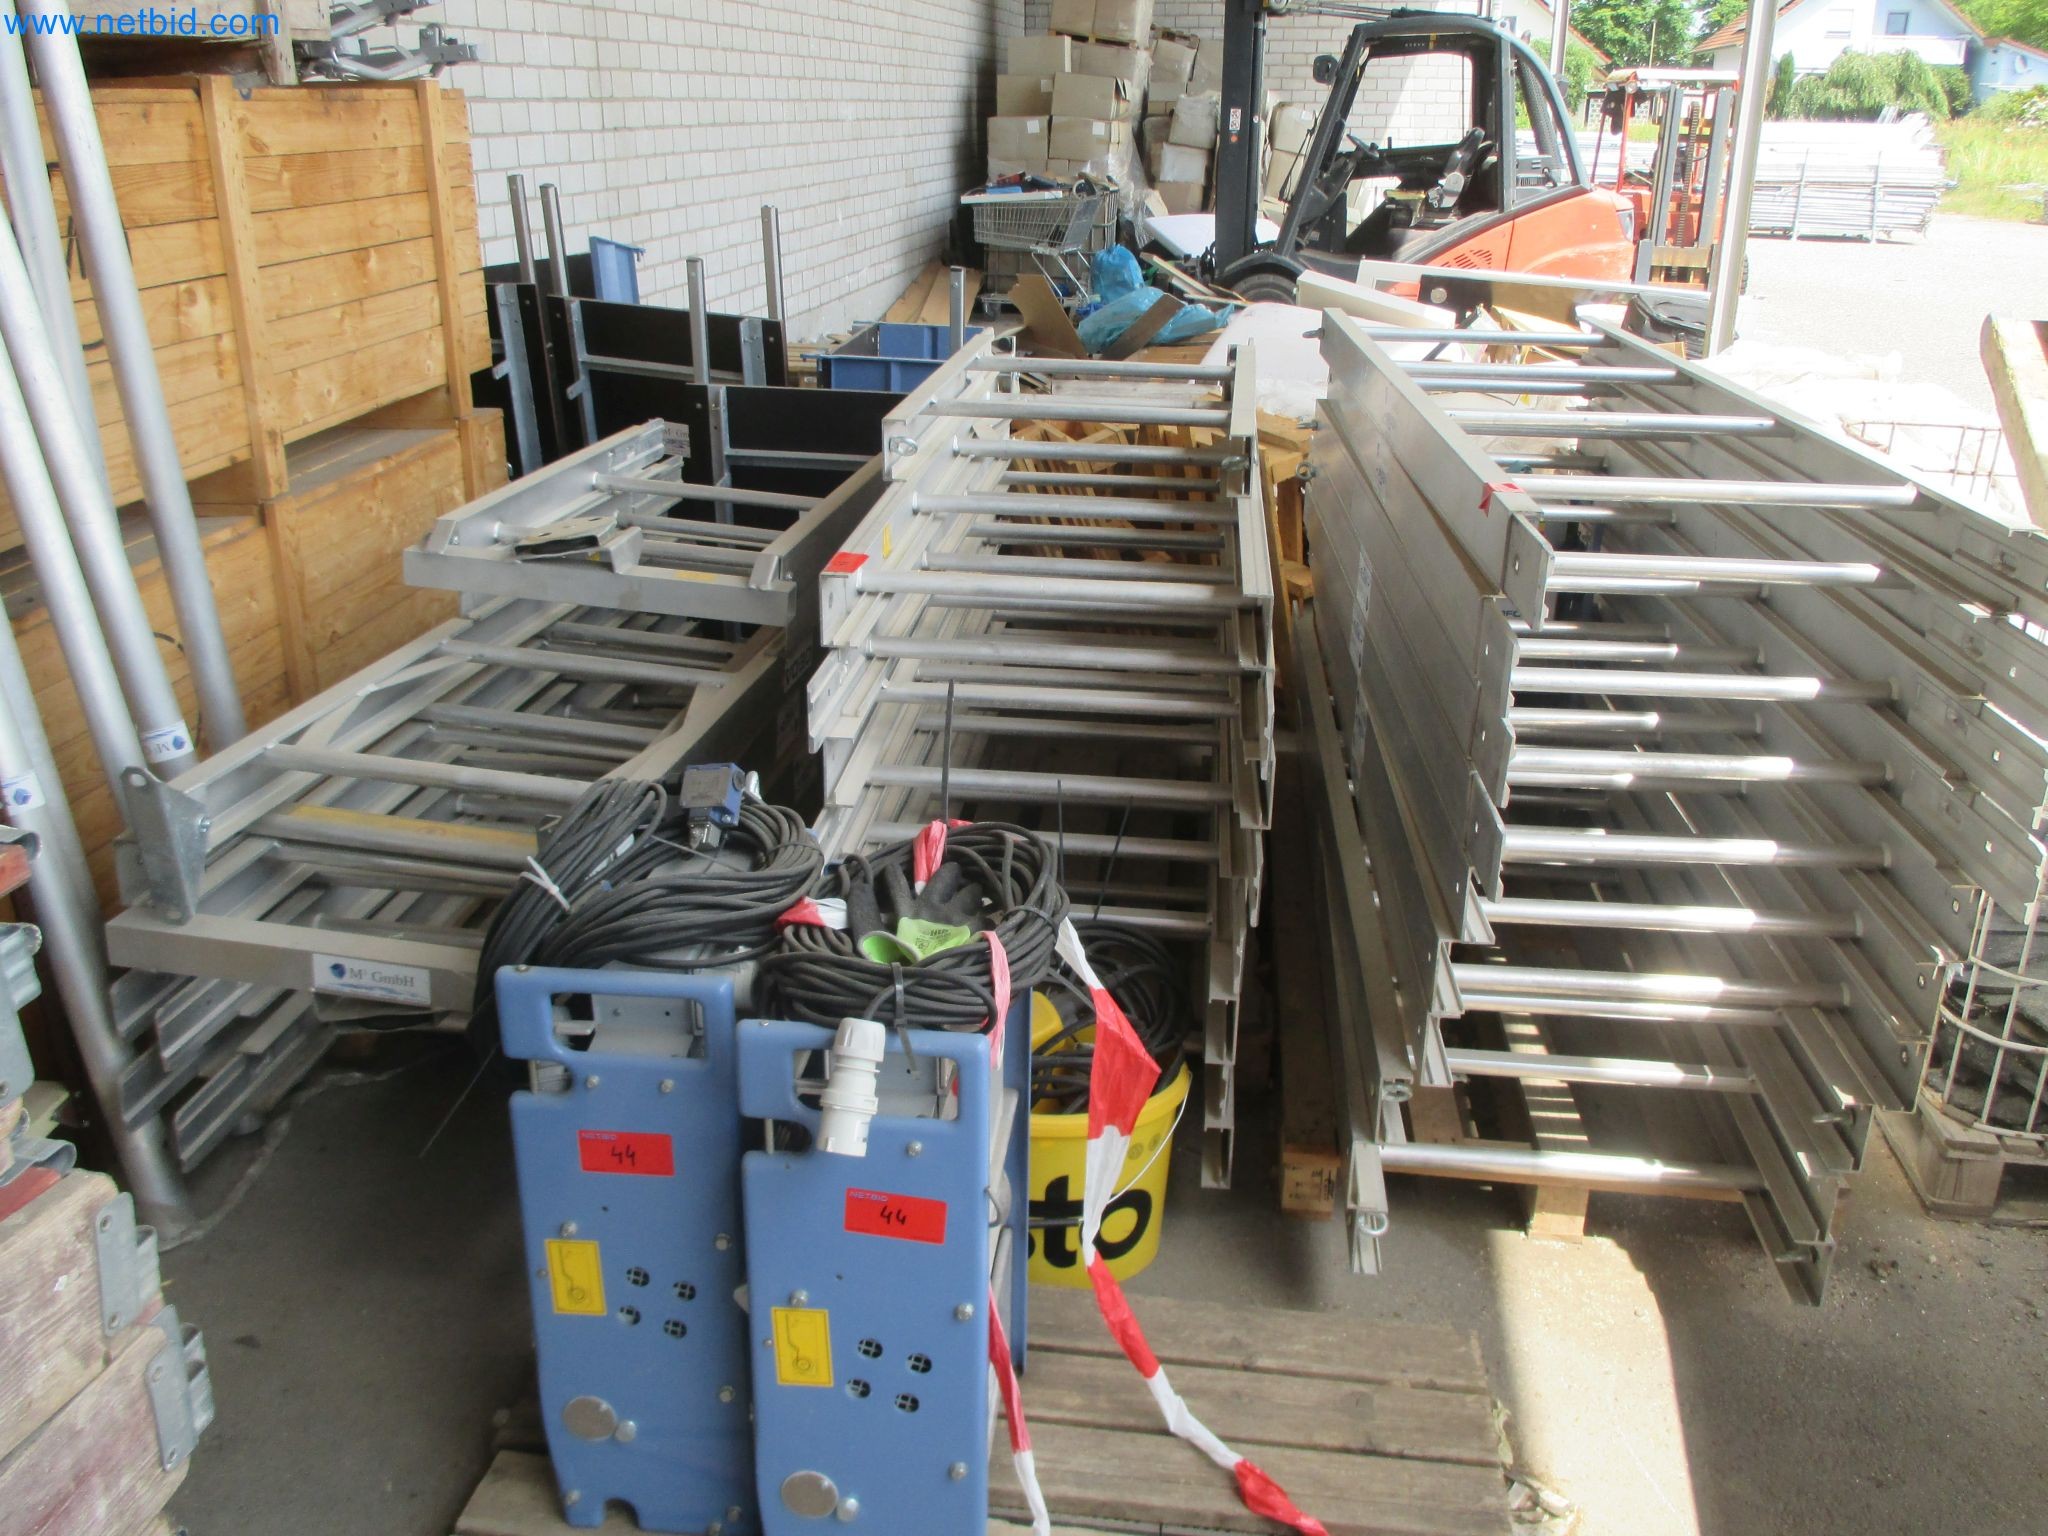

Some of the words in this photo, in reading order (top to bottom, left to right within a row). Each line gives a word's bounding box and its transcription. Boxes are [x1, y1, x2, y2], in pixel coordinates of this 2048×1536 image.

[371, 971, 415, 988] GmbH
[611, 1143, 636, 1168] 44
[880, 1204, 907, 1226] 44
[1028, 1174, 1152, 1268] to
